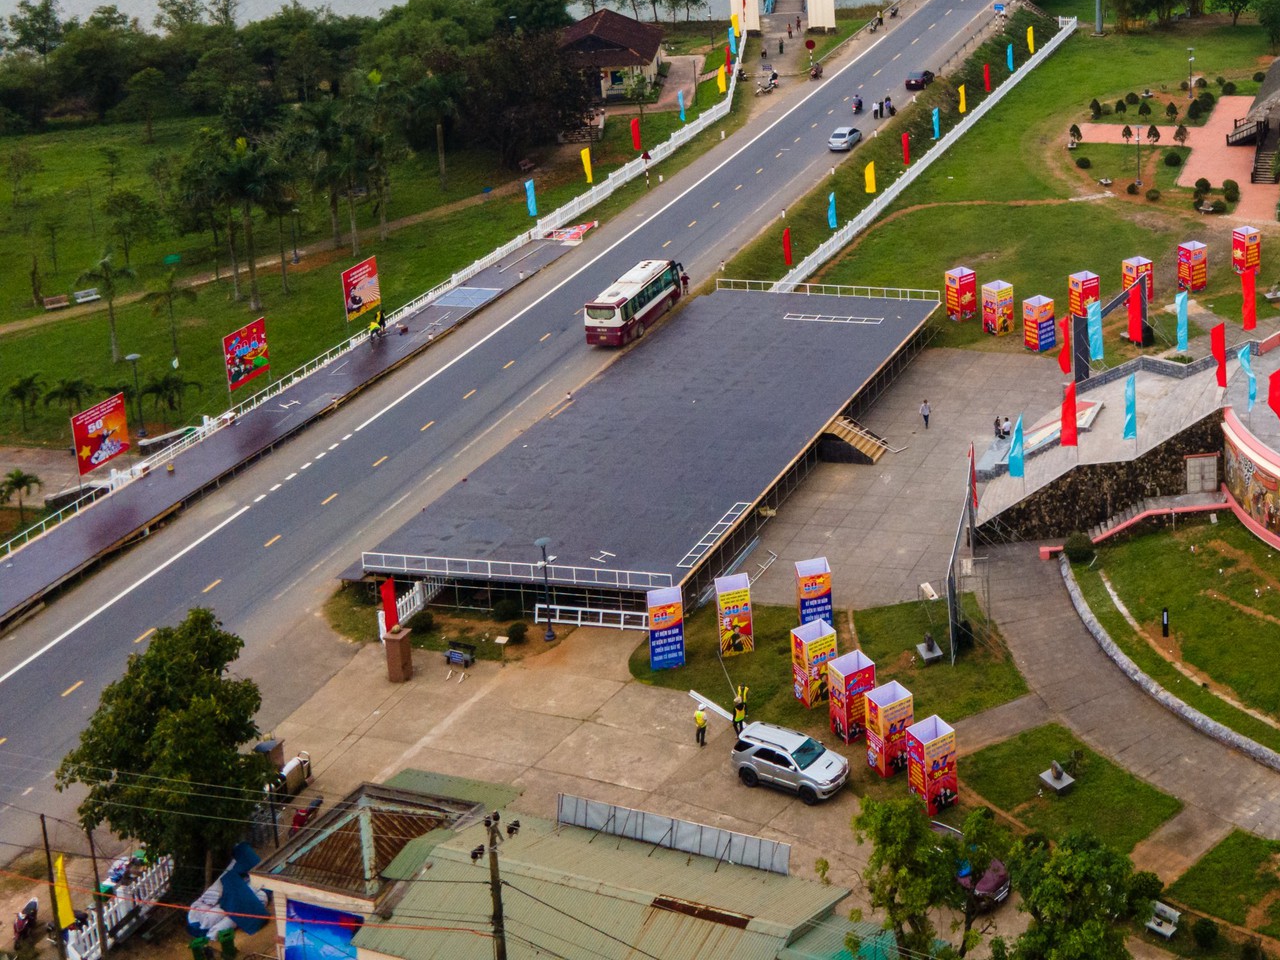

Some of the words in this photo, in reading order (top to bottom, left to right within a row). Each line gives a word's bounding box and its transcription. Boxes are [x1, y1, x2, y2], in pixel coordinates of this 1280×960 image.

[88, 419, 103, 434] 50
[804, 582, 818, 592] 50
[653, 611, 668, 622] 50
[889, 718, 906, 734] 47
[890, 730, 906, 742] 30-4
[931, 754, 948, 770] 47
[933, 766, 949, 779] 30-4
